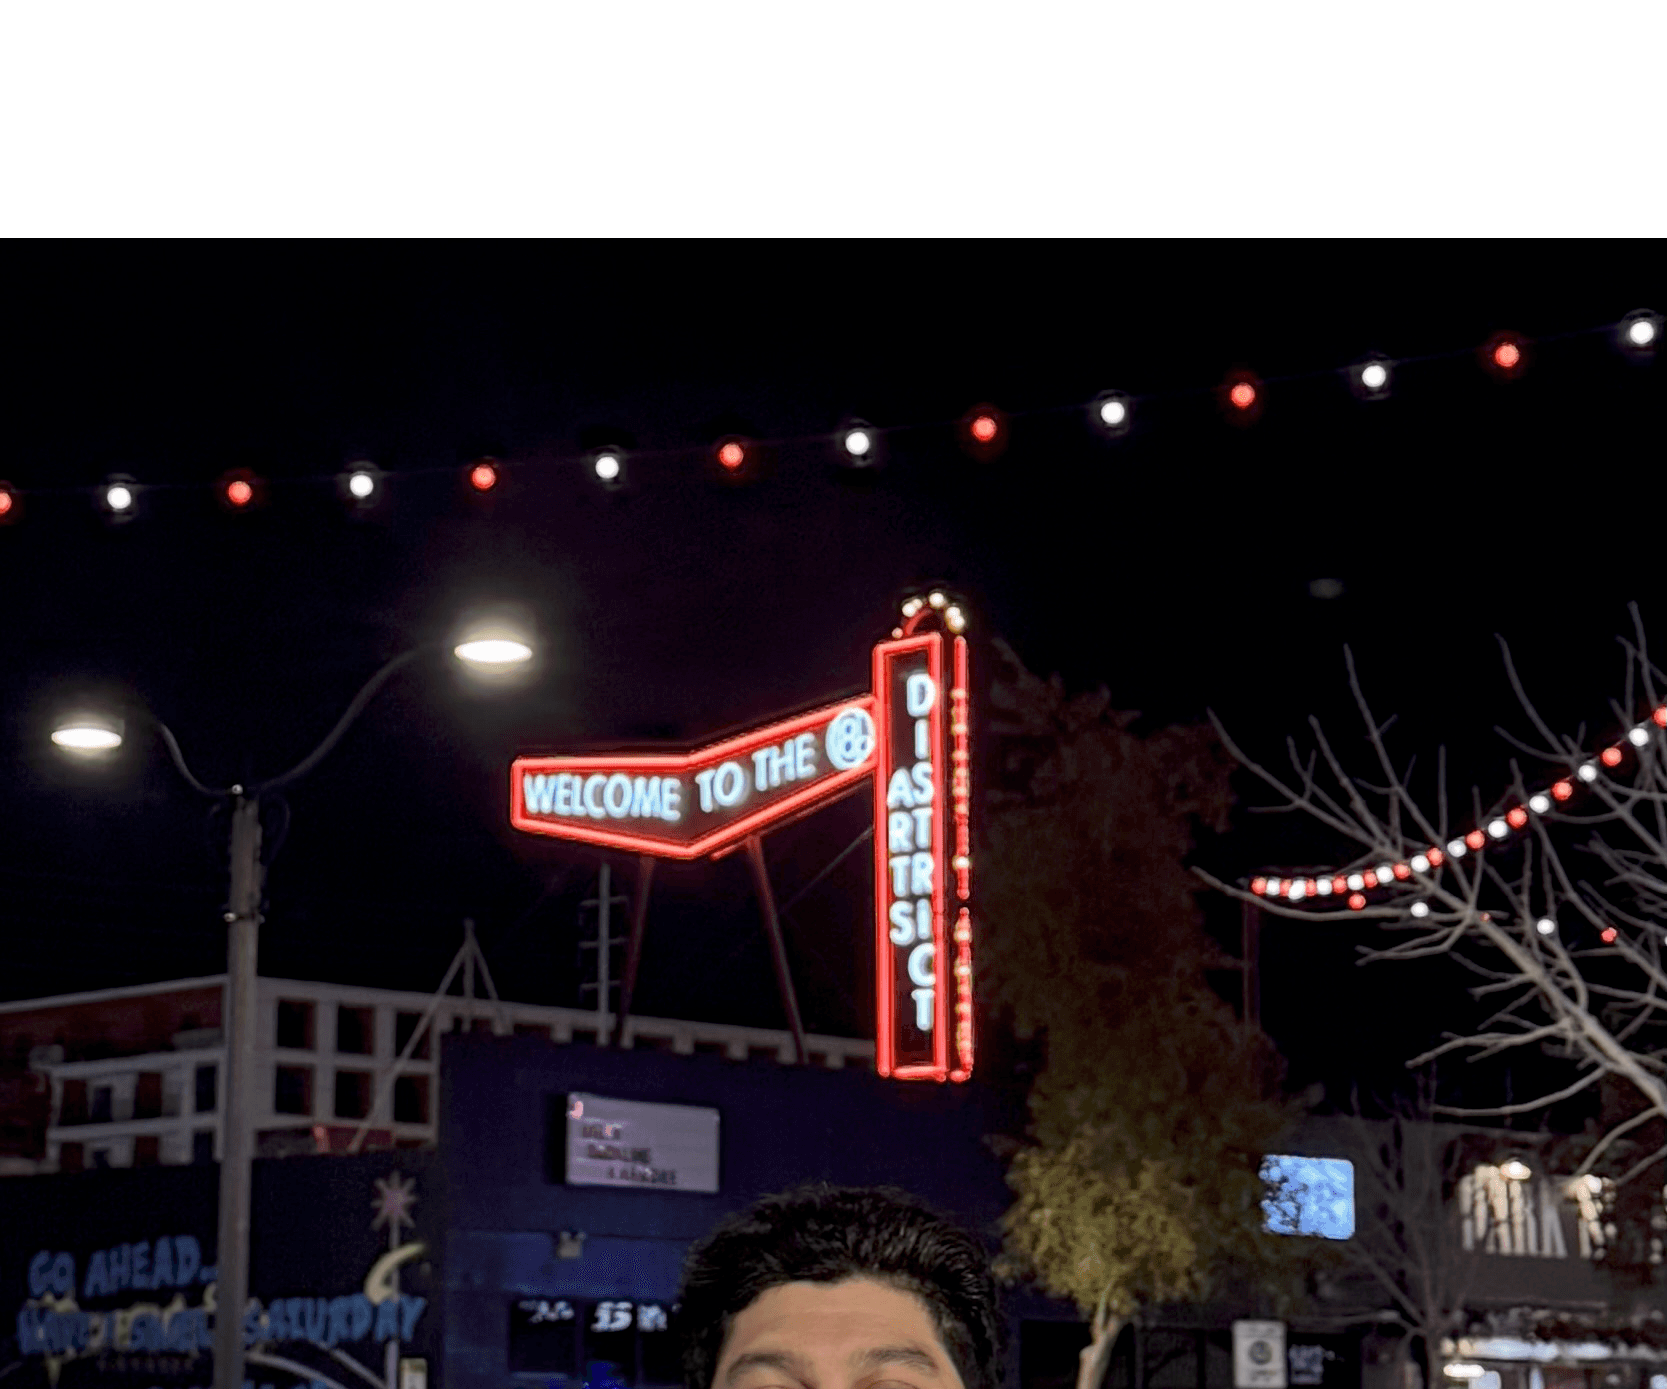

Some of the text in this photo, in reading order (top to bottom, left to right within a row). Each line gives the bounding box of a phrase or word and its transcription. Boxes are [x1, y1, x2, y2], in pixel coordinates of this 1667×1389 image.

[523, 772, 681, 822] WELCOME
[696, 761, 747, 813] TO
[752, 733, 817, 791] THE
[28, 1249, 75, 1297] GO
